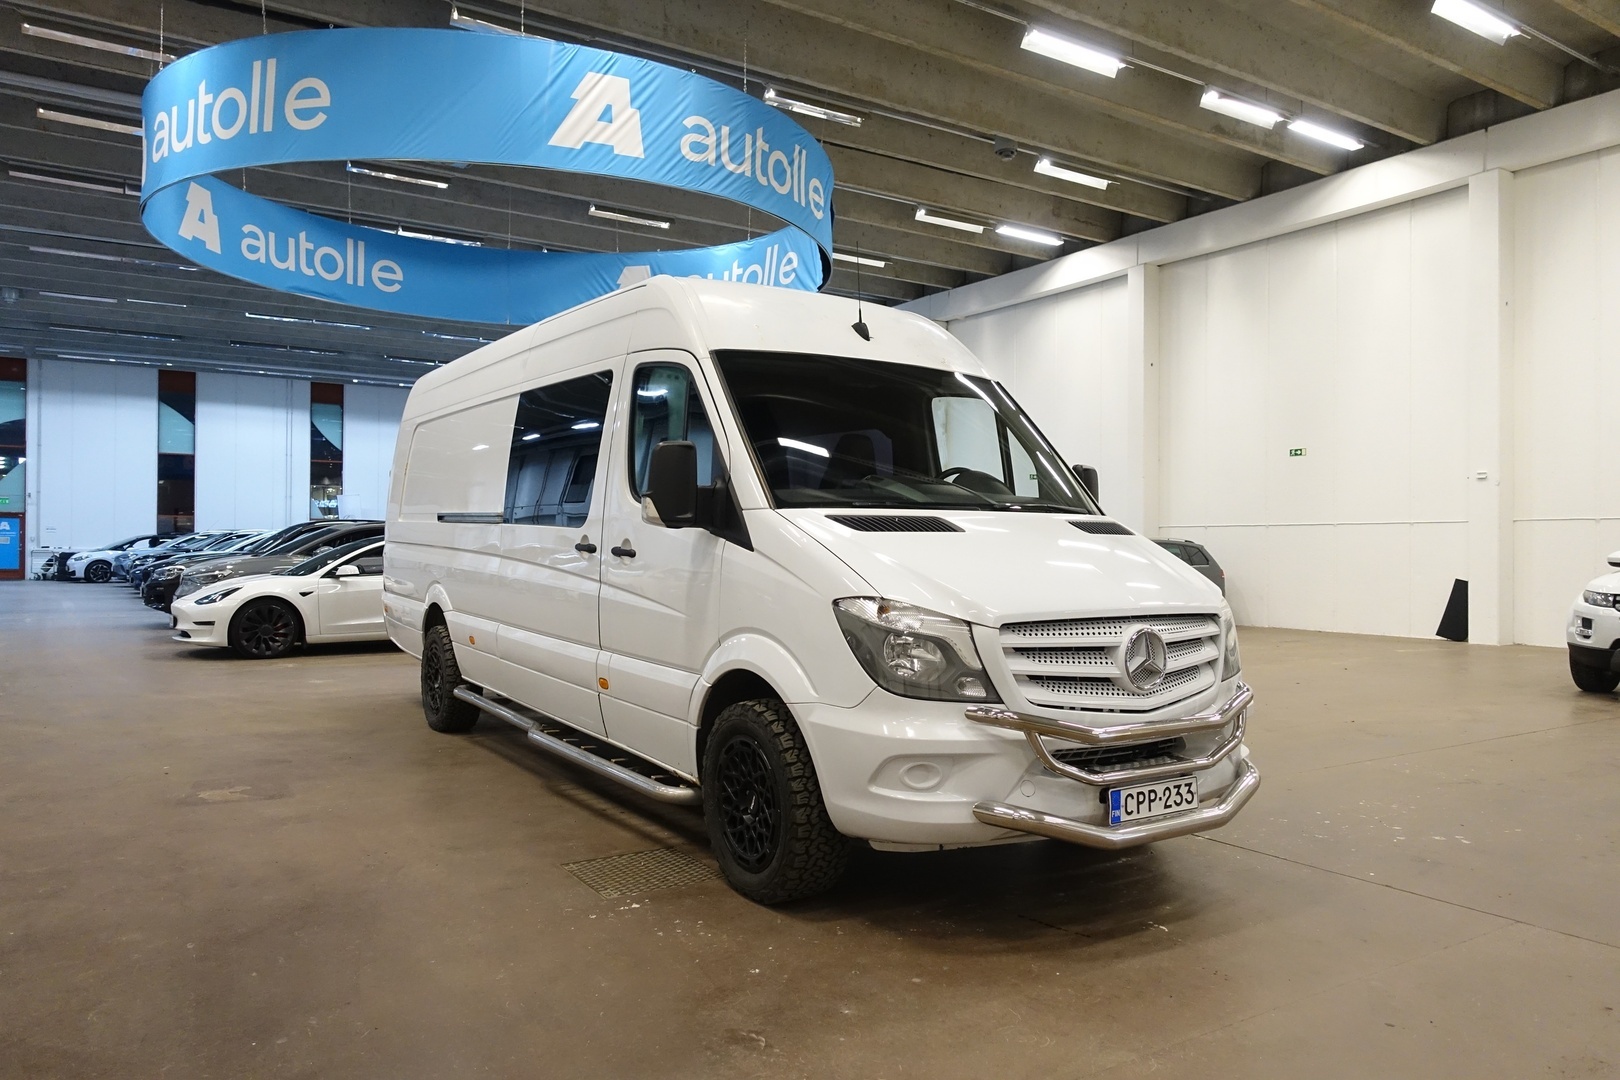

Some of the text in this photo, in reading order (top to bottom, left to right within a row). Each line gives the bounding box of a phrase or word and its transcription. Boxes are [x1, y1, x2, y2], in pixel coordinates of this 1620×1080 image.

[152, 58, 331, 163] autolle
[547, 71, 825, 220] A autolle
[178, 181, 404, 293] A autolle
[690, 244, 799, 287] tolle
[1124, 781, 1195, 816] CPP-233
